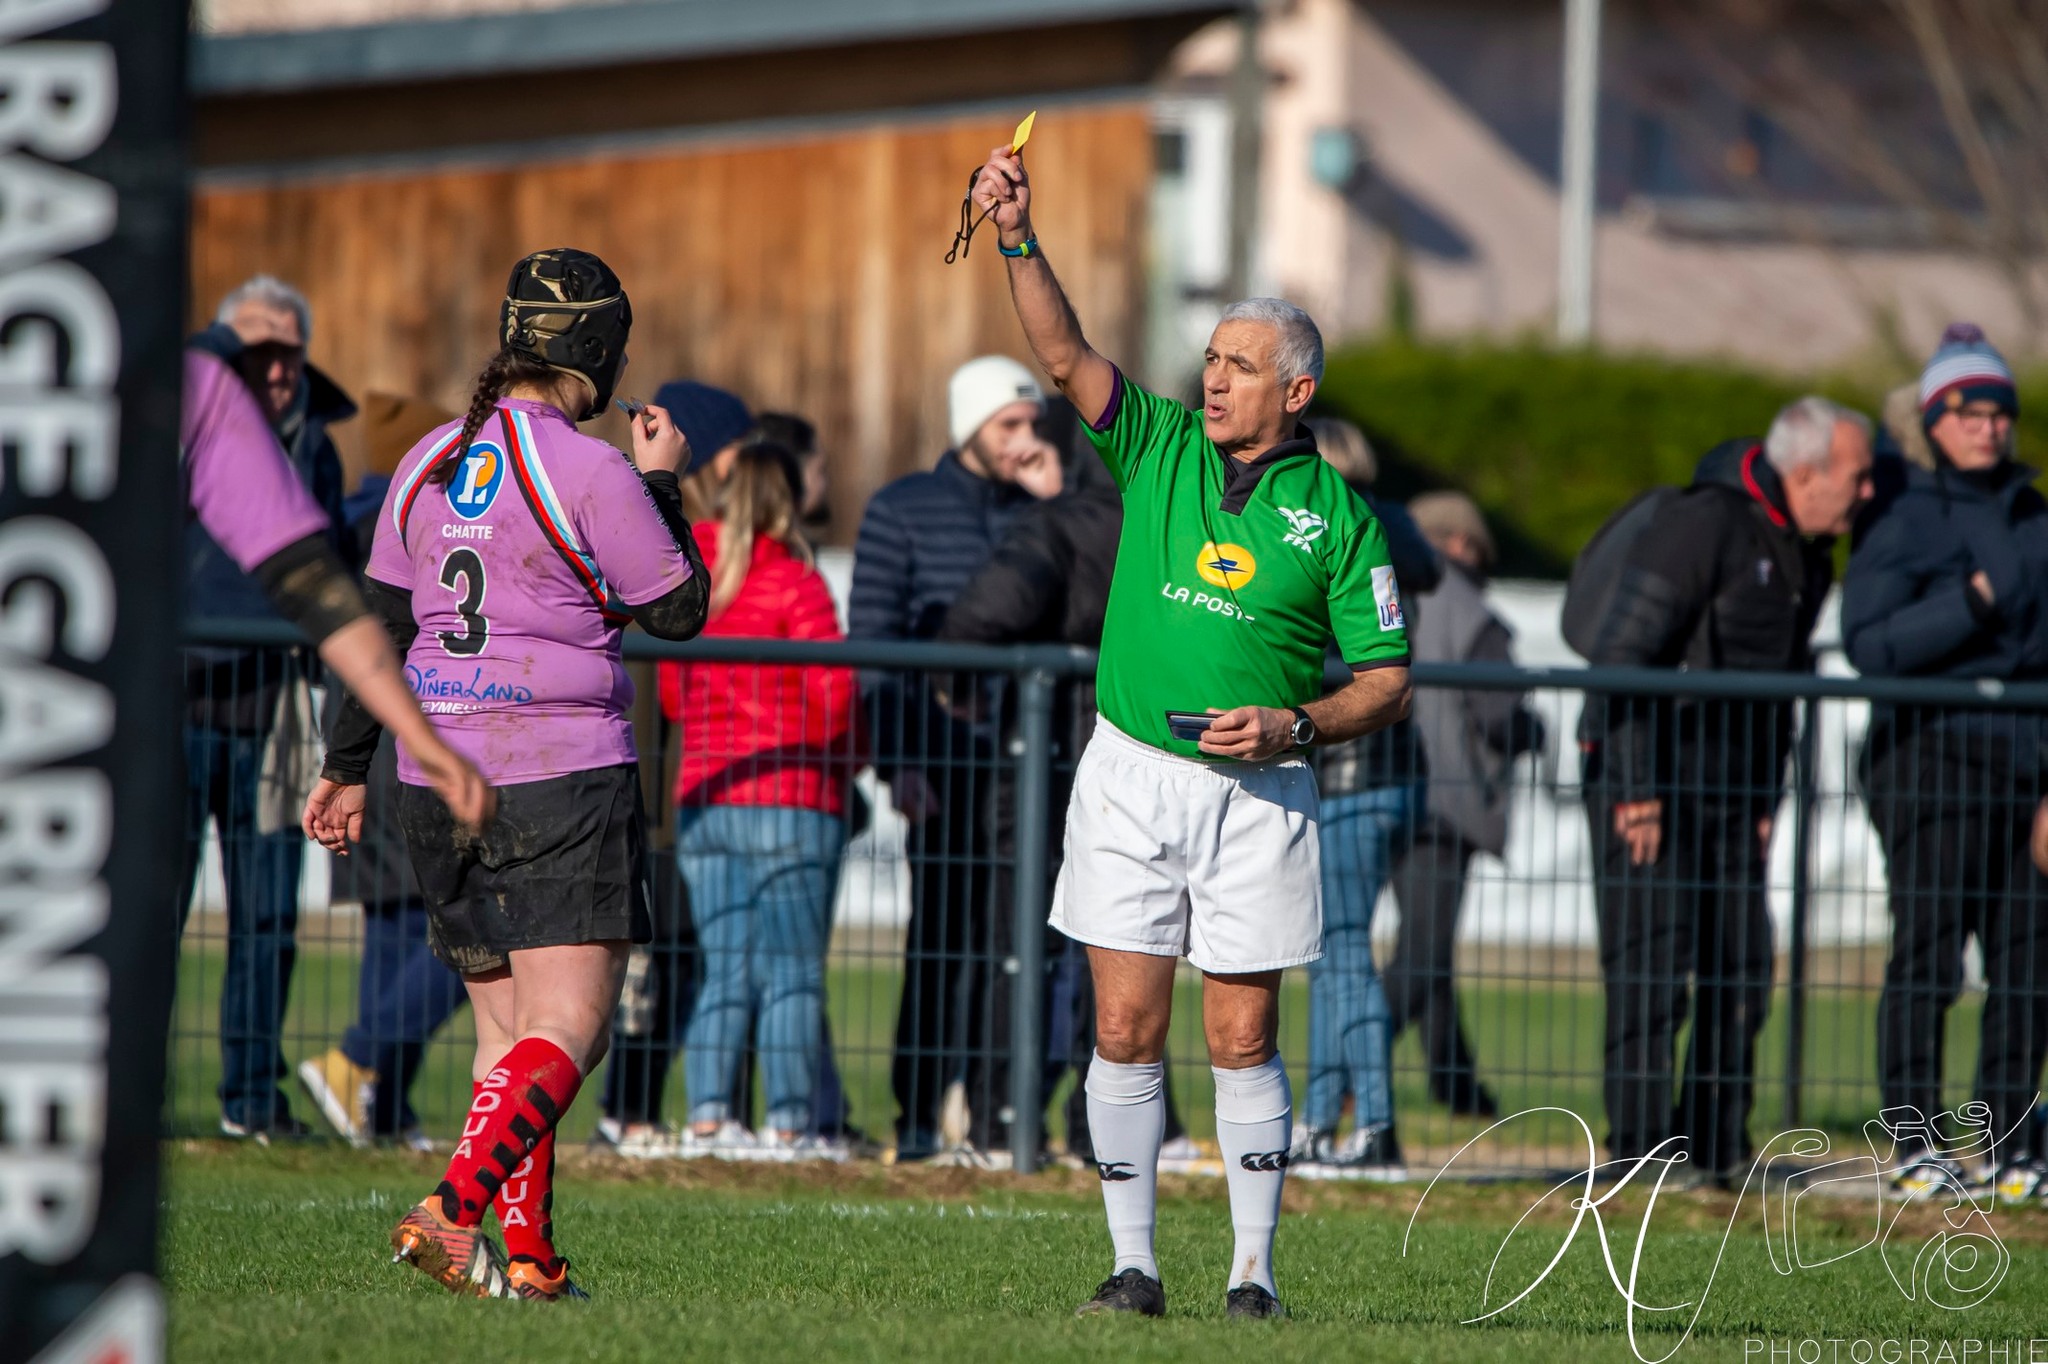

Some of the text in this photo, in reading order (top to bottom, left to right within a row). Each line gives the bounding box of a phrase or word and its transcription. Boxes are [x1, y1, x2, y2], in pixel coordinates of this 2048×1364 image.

[442, 524, 494, 540] CHATTE
[435, 546, 490, 659] 3
[1162, 582, 1190, 602] LA
[0, 516, 117, 1266] GARNIER
[451, 1067, 512, 1159] SOUA
